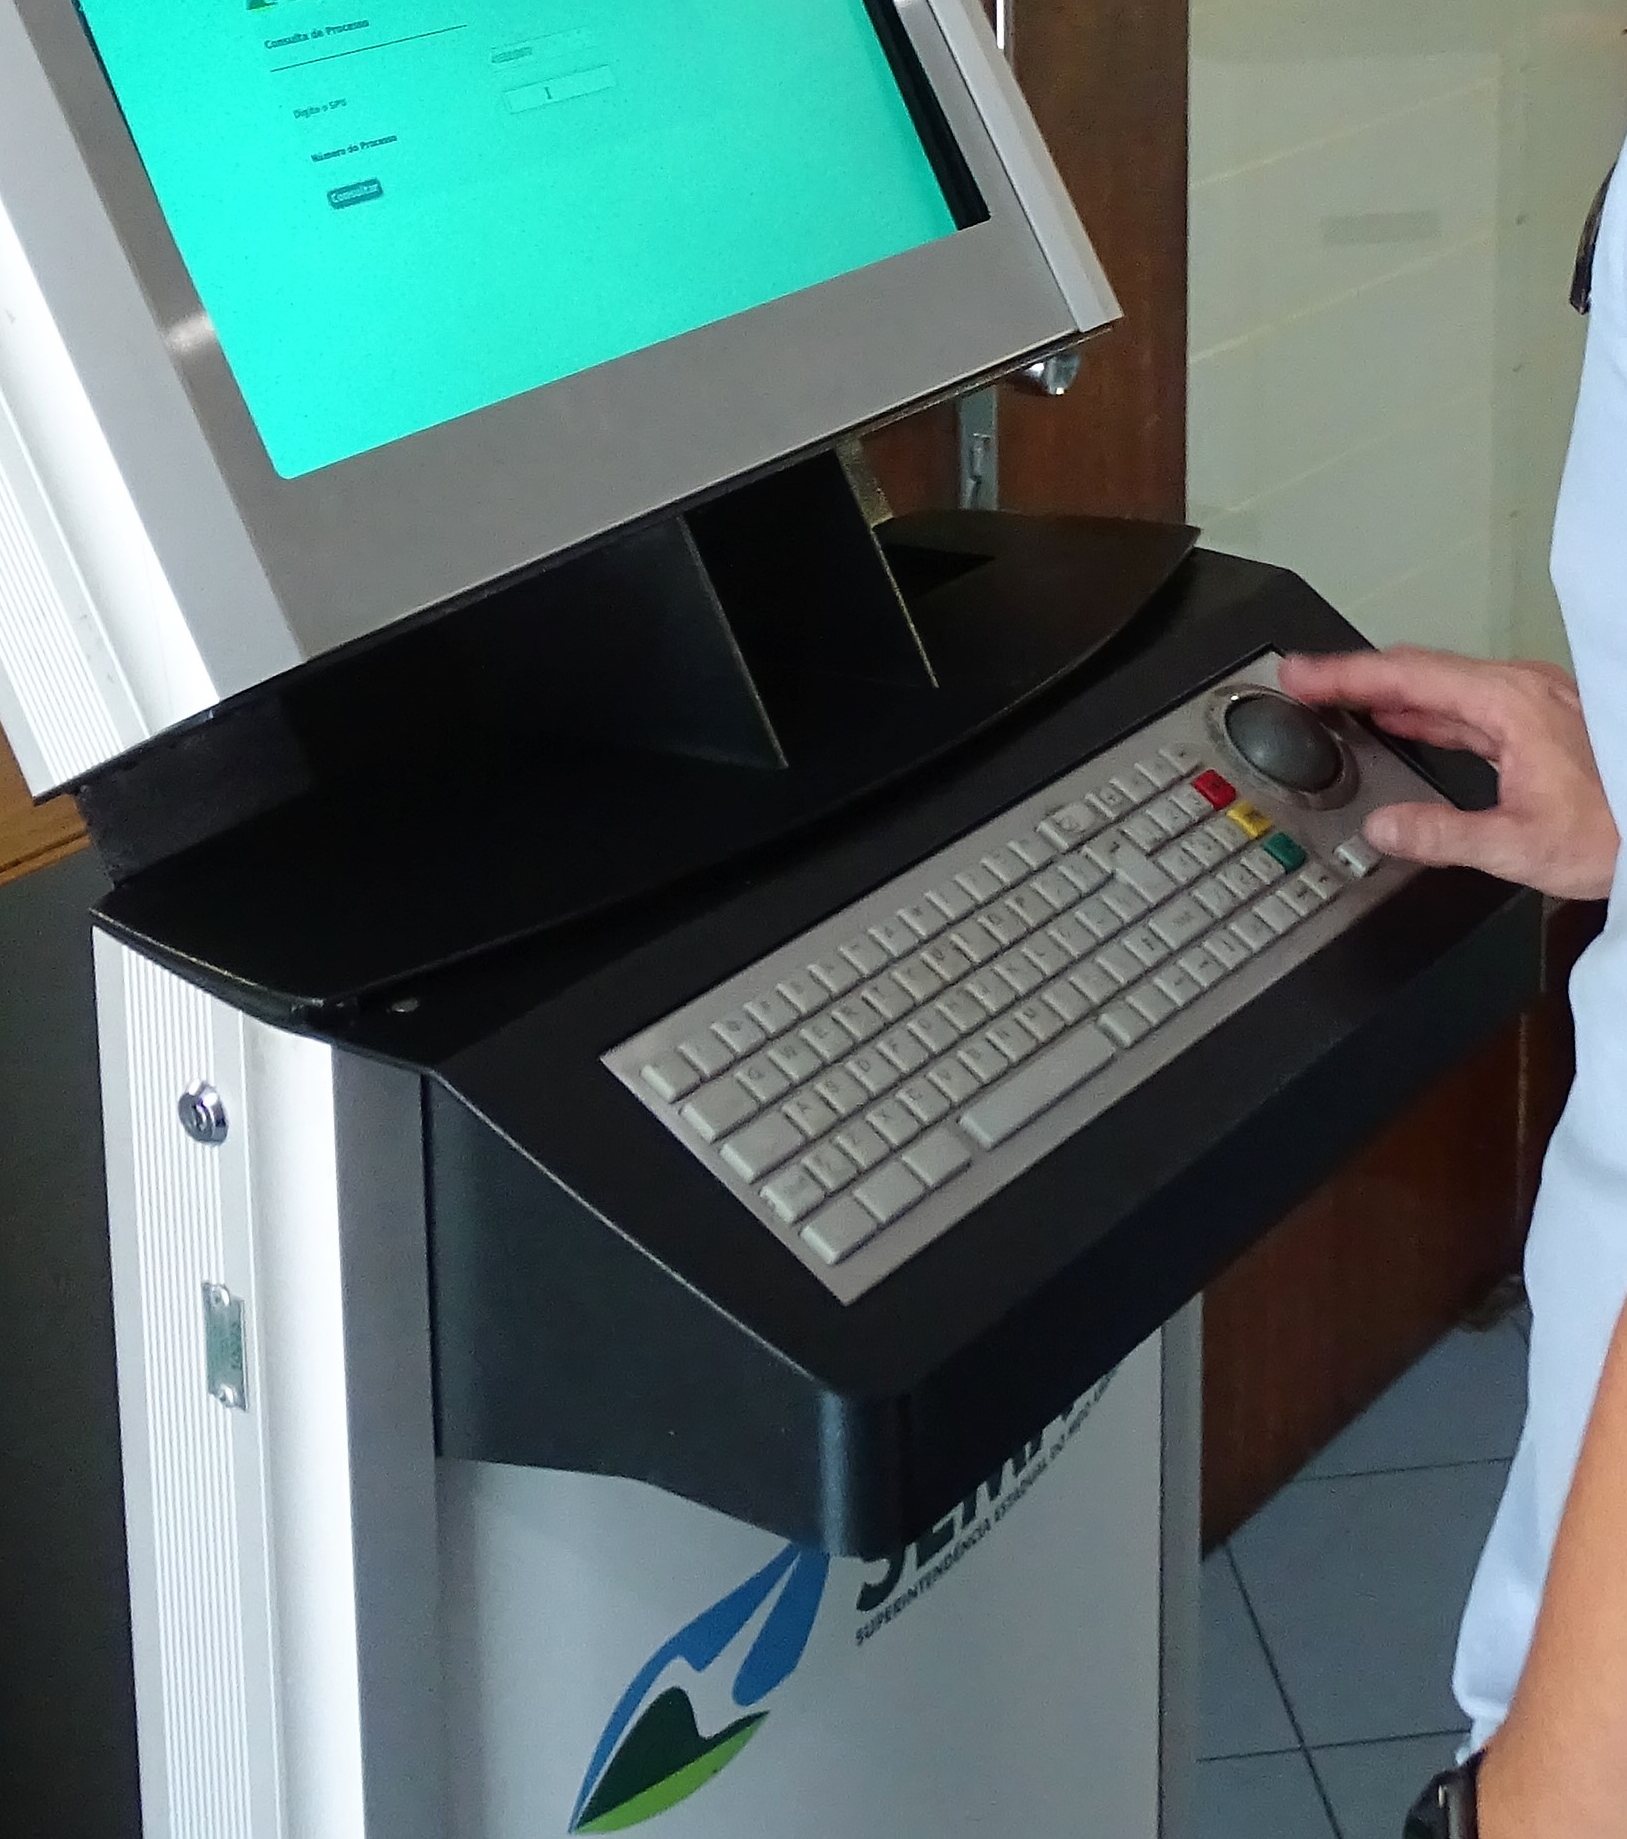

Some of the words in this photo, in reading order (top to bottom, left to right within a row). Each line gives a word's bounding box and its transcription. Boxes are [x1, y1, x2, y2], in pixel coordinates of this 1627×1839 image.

[264, 32, 308, 49] Consulta
[309, 26, 324, 39] de
[325, 18, 369, 35] Processo
